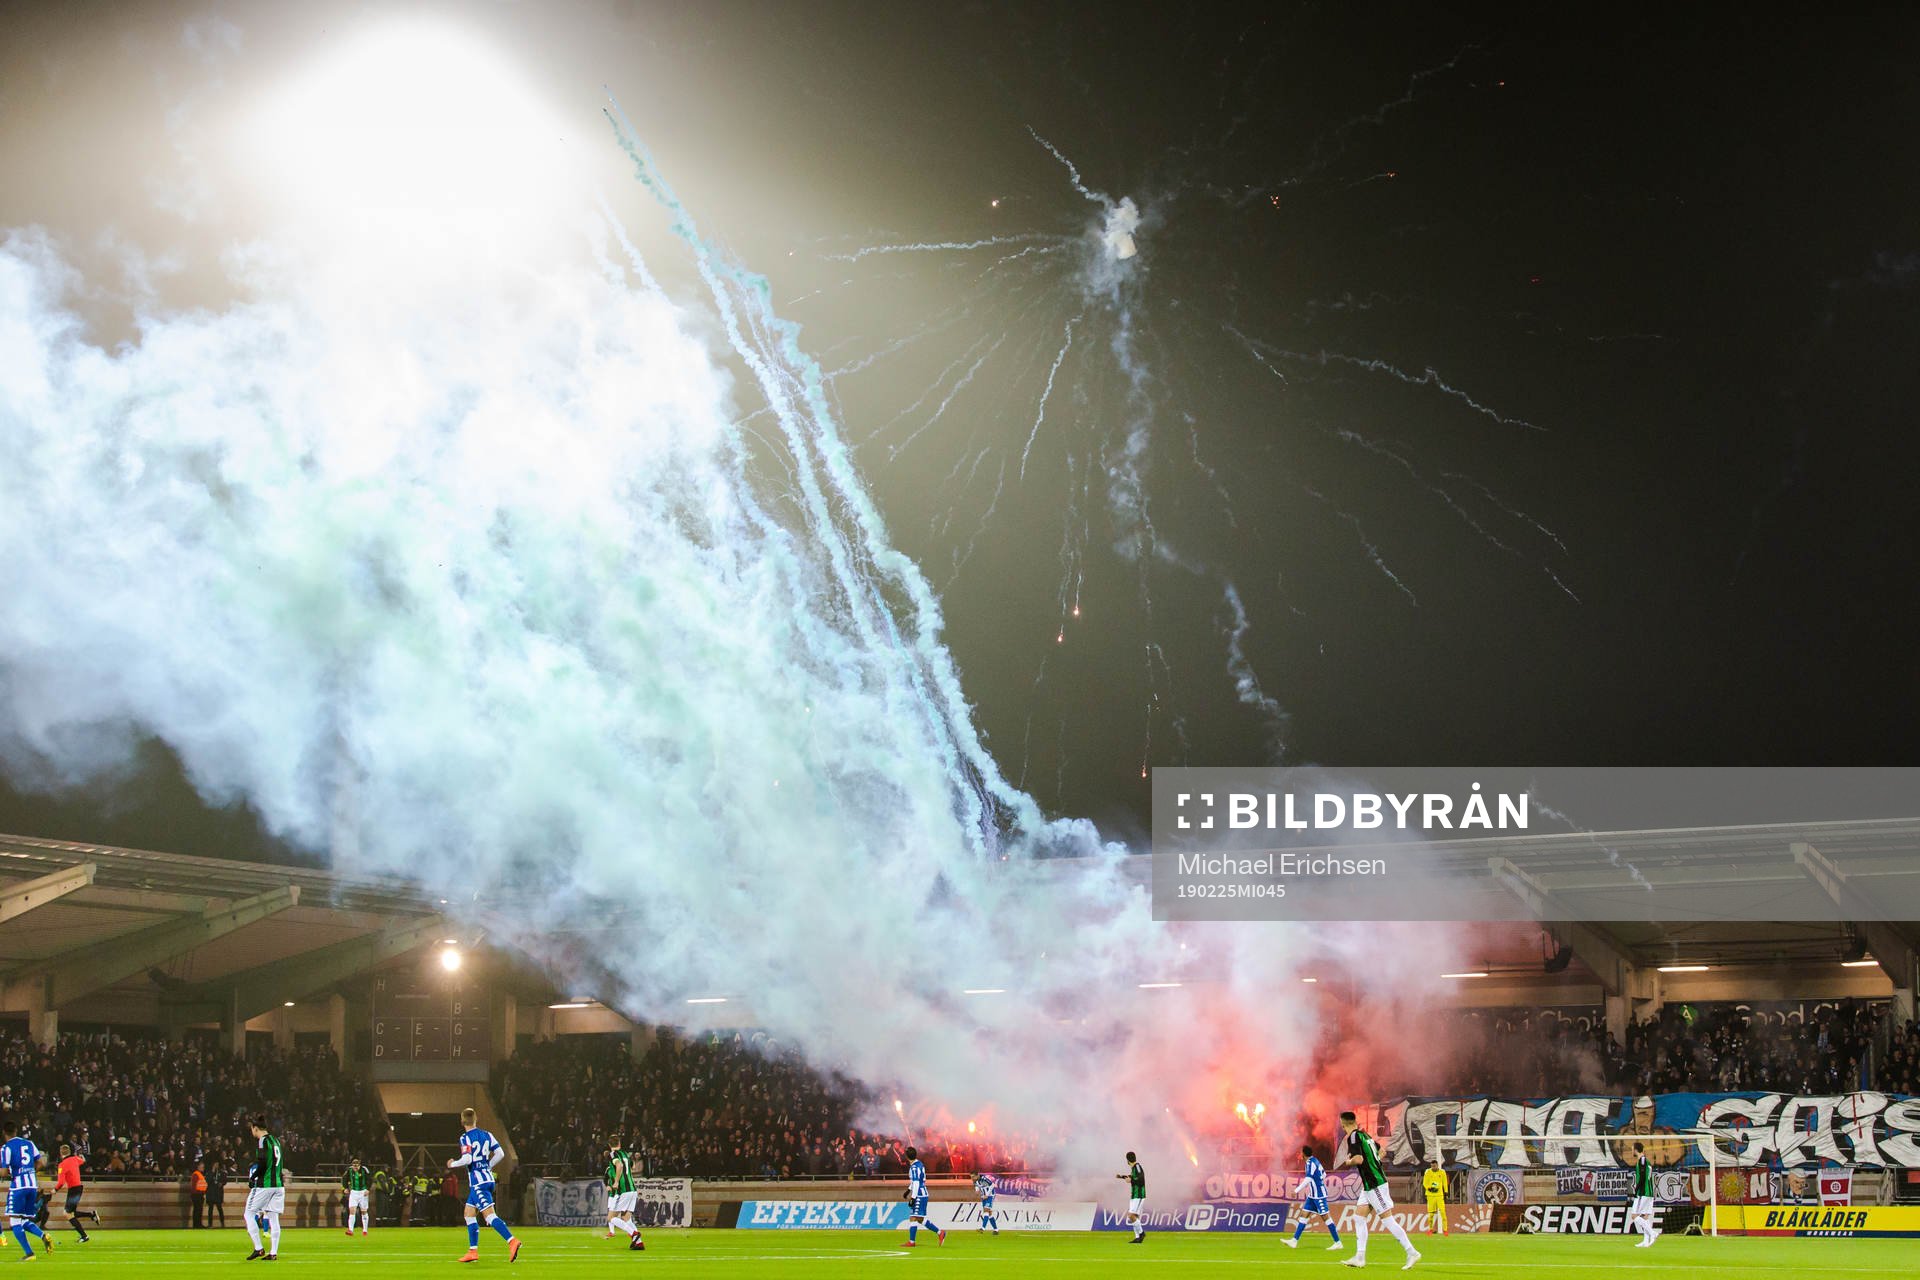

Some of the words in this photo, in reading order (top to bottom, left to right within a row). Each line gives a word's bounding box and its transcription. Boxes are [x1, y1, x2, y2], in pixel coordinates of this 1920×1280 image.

[454, 1002, 462, 1015] B
[415, 1022, 423, 1035] E
[375, 1045, 384, 1057] D
[453, 1045, 461, 1057] H
[21, 1145, 31, 1165] 5
[273, 1145, 282, 1167] 9
[472, 1140, 491, 1162] 24
[751, 1201, 897, 1225] EFFEKTIV
[1188, 1206, 1211, 1227] IP
[1213, 1208, 1280, 1227] Phone
[1337, 1205, 1440, 1232] Rnova
[1524, 1205, 1666, 1235] SERNEKE
[1765, 1207, 1868, 1228] BLÅKLÄDER
